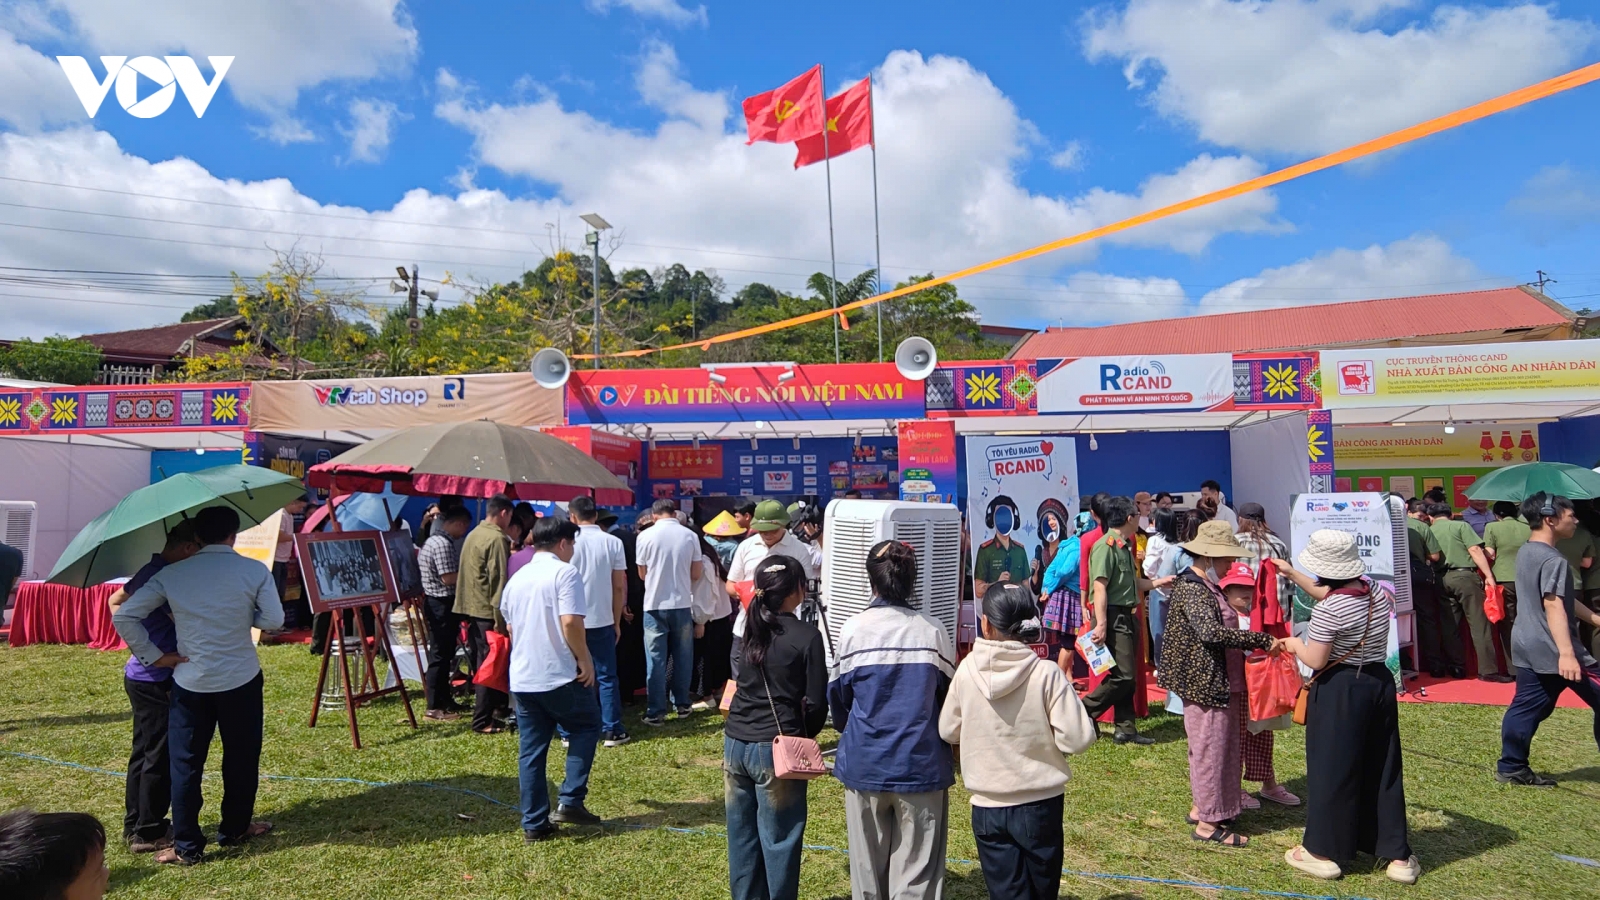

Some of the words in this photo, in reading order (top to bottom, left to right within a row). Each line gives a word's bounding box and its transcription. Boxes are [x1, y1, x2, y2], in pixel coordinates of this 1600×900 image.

[1386, 357, 1405, 366] CỤC
[1406, 355, 1443, 365] TRUYỀN
[1445, 353, 1478, 363] THÔNG
[1480, 353, 1508, 362] CAND
[1386, 366, 1413, 378] NHÀ
[1414, 364, 1446, 377] XUẤT
[1448, 364, 1472, 375] BẢN
[1475, 362, 1508, 374] CÔNG
[1511, 363, 1528, 373] AN
[1531, 360, 1567, 372] NHÂN
[1569, 359, 1596, 371] DÂN
[379, 387, 428, 407] Shop
[580, 384, 638, 407] VOV
[643, 383, 679, 405] ĐÀI
[755, 381, 796, 403] NÓI
[800, 380, 850, 407] VIỆT
[854, 383, 904, 401] NAM
[1085, 396, 1102, 404] PHÁT
[1144, 394, 1160, 402] NINH
[1353, 438, 1378, 447] CÔNG
[1394, 438, 1422, 446] NHÂN
[1423, 437, 1443, 445] DÂN
[991, 448, 1003, 458] TÔI
[1004, 446, 1018, 456] YÊU
[1018, 445, 1040, 455] RADIO
[994, 458, 1046, 476] RCAND
[767, 472, 789, 481] VOV
[1351, 500, 1370, 508] VOV
